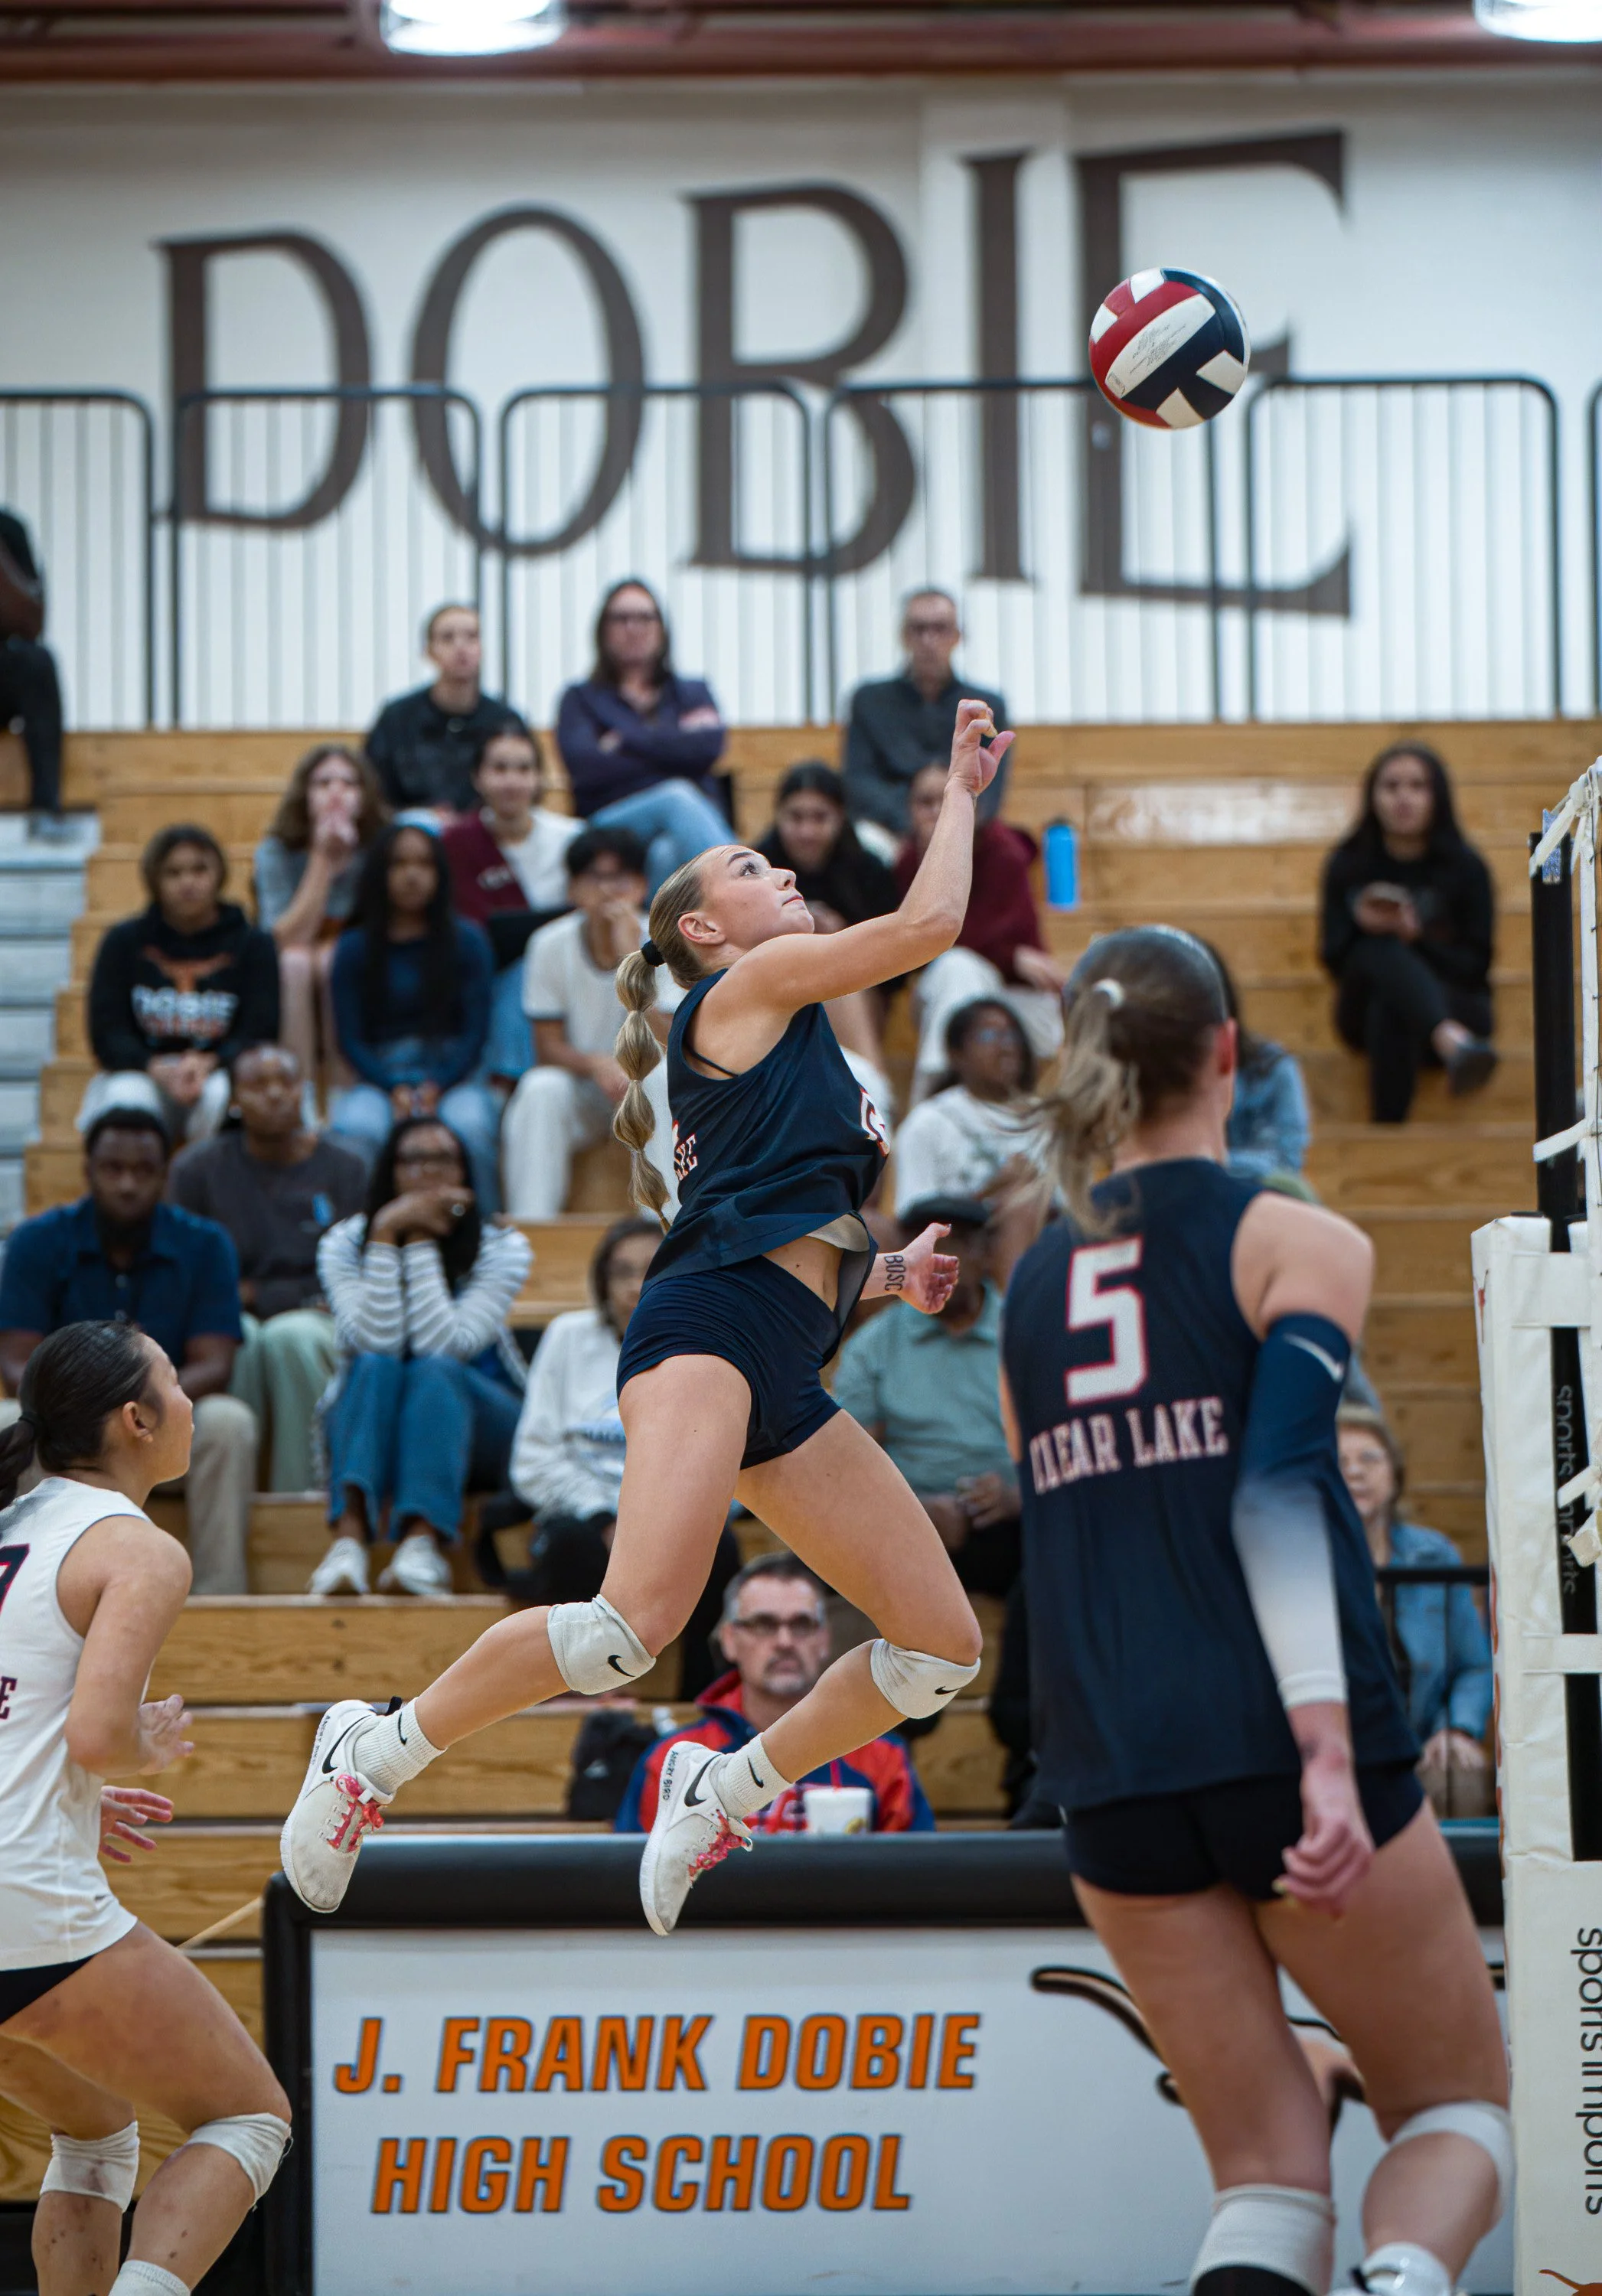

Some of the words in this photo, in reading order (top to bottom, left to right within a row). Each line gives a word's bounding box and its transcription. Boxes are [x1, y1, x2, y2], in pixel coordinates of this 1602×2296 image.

[153, 129, 1350, 618] DOBIE
[884, 1255, 905, 1291] BOSC
[1065, 1234, 1148, 1407] 5
[1125, 1396, 1228, 1468] LAKE
[334, 2017, 403, 2095] J.
[436, 2014, 713, 2093] FRANK
[736, 2013, 981, 2091] DOBIE
[370, 2136, 570, 2214] HIGH
[596, 2133, 912, 2213] SCHOOL
